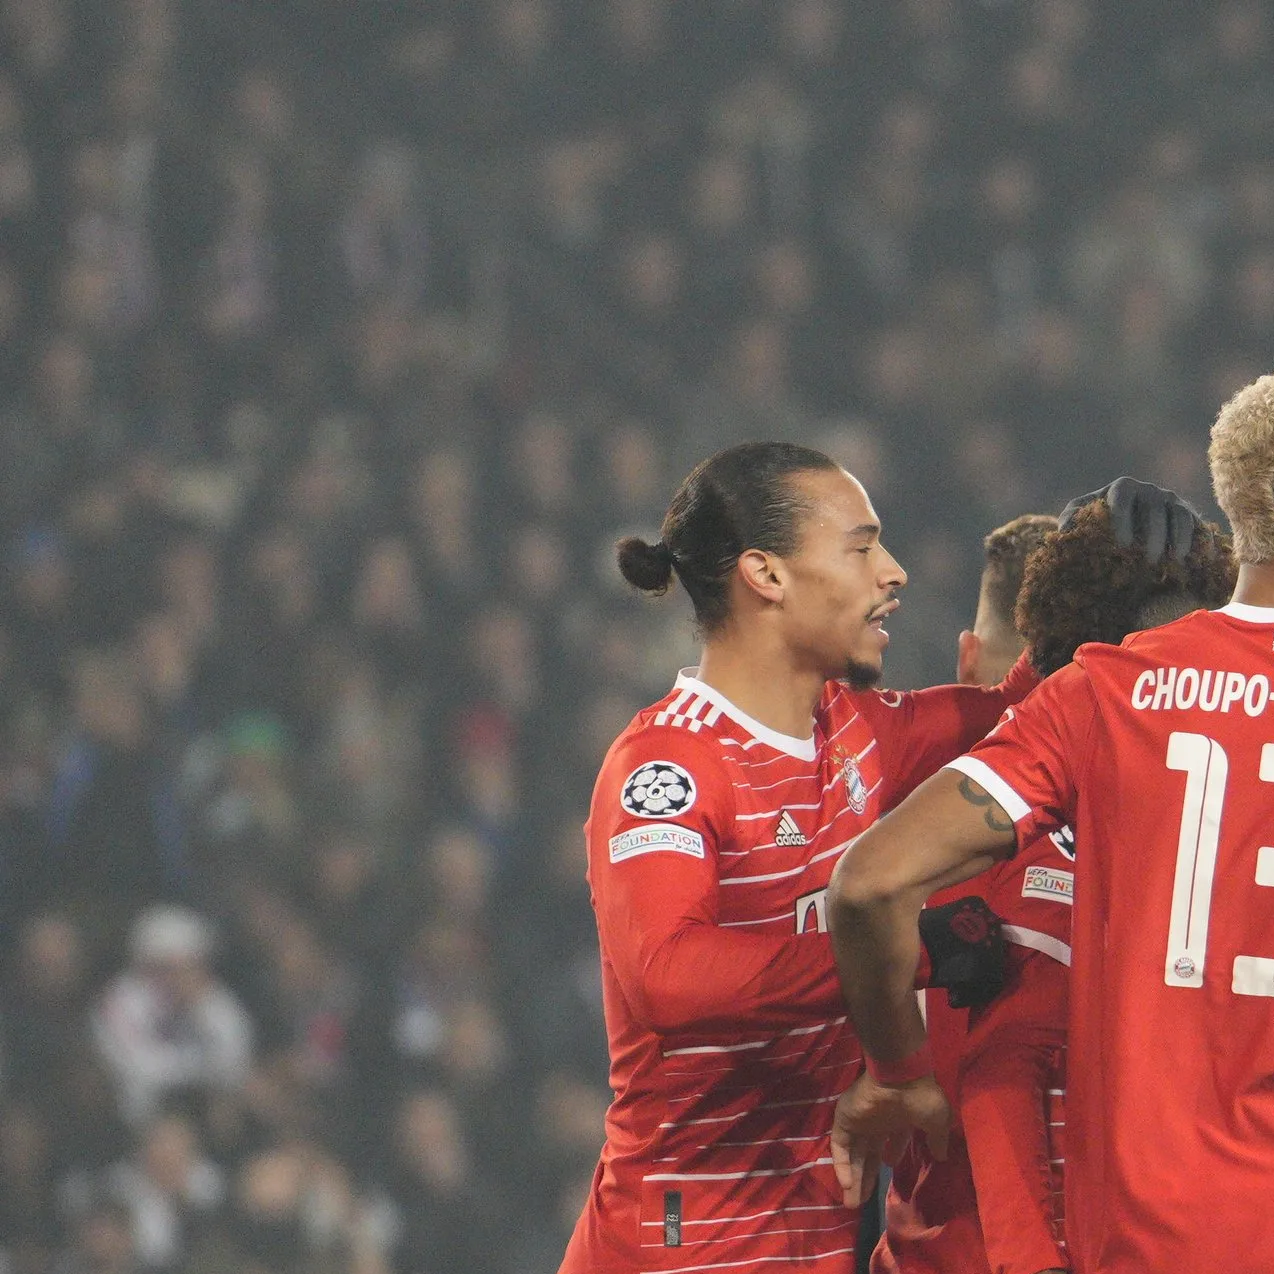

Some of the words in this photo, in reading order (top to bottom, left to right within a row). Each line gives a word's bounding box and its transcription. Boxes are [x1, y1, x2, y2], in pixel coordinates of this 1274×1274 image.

[646, 778, 666, 800] 6
[775, 832, 806, 847] adidas
[1027, 868, 1048, 877] UEFA
